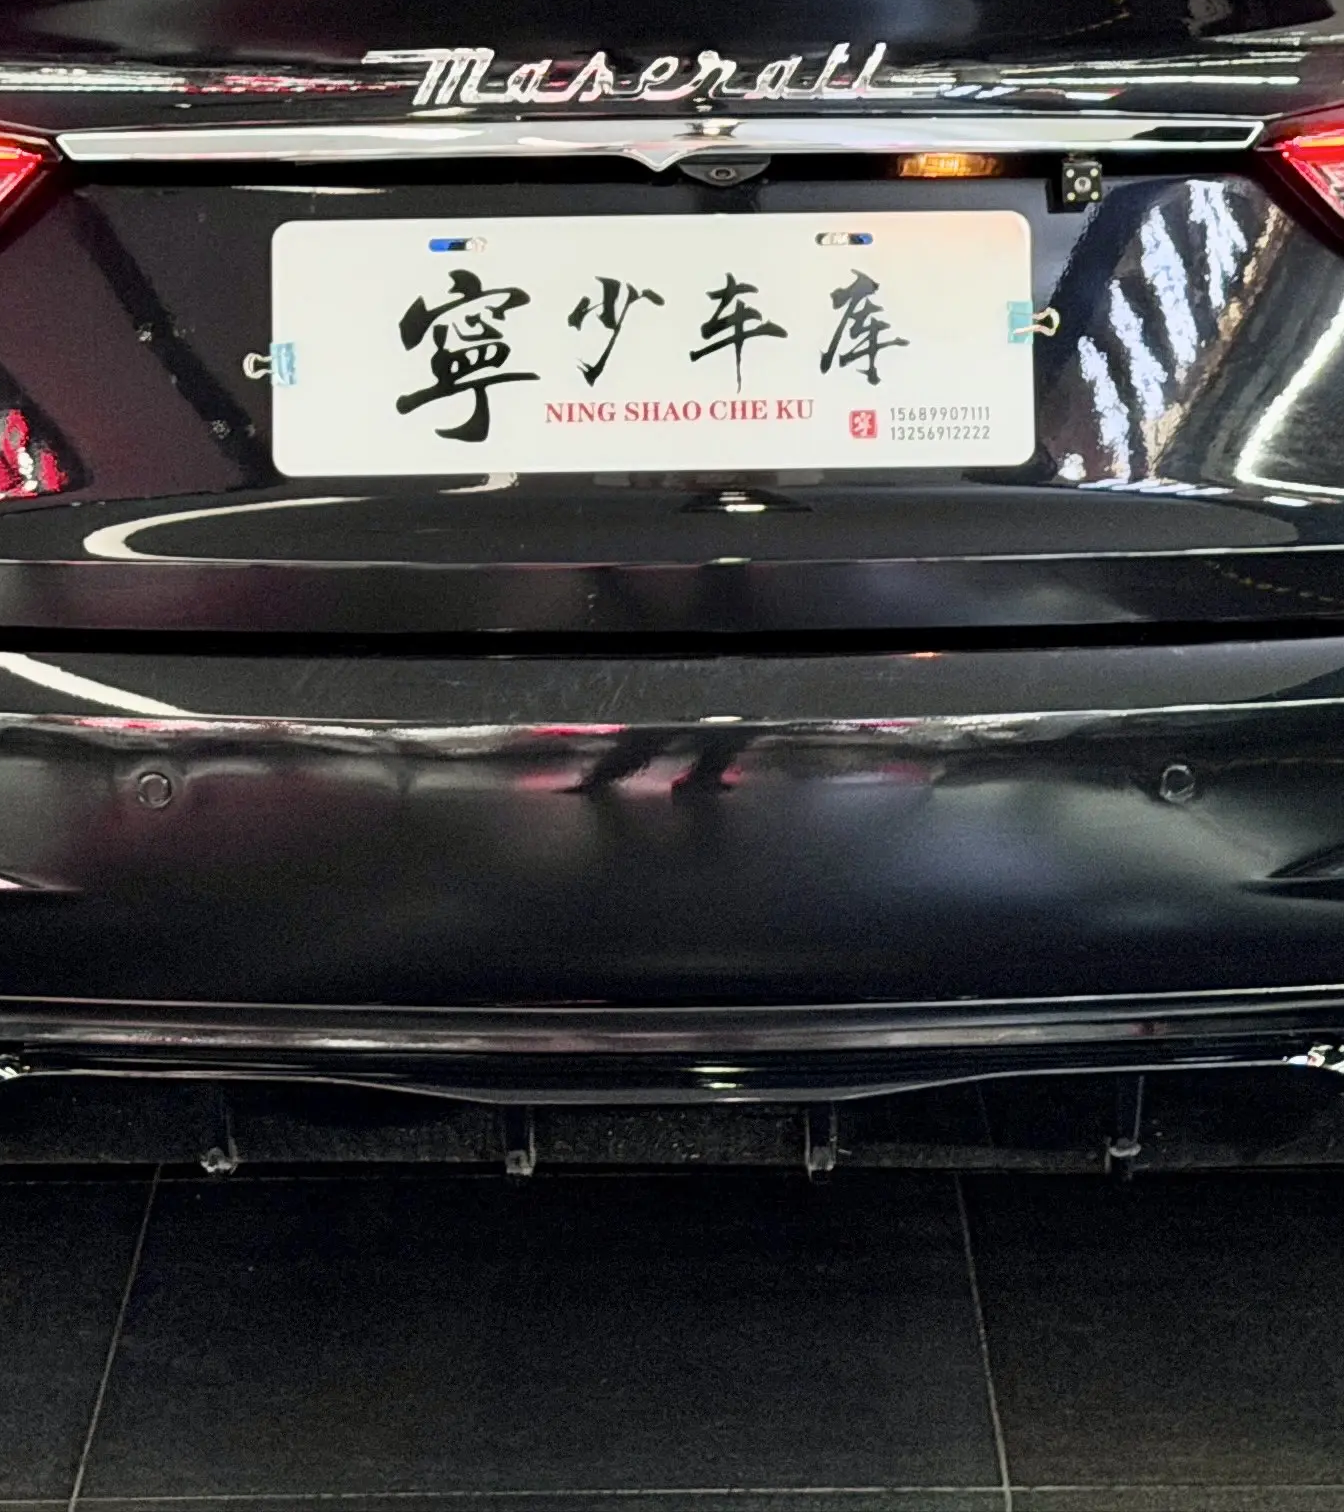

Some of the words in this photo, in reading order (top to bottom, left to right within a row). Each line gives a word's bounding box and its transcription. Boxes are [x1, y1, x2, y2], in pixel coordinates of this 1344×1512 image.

[362, 42, 956, 107] Maserati
[544, 402, 617, 424] NING
[624, 400, 702, 422] SHAO
[709, 399, 769, 421] CHE
[775, 398, 815, 420] KU
[889, 406, 991, 422] 15689907111
[889, 425, 991, 441] 13256912222
